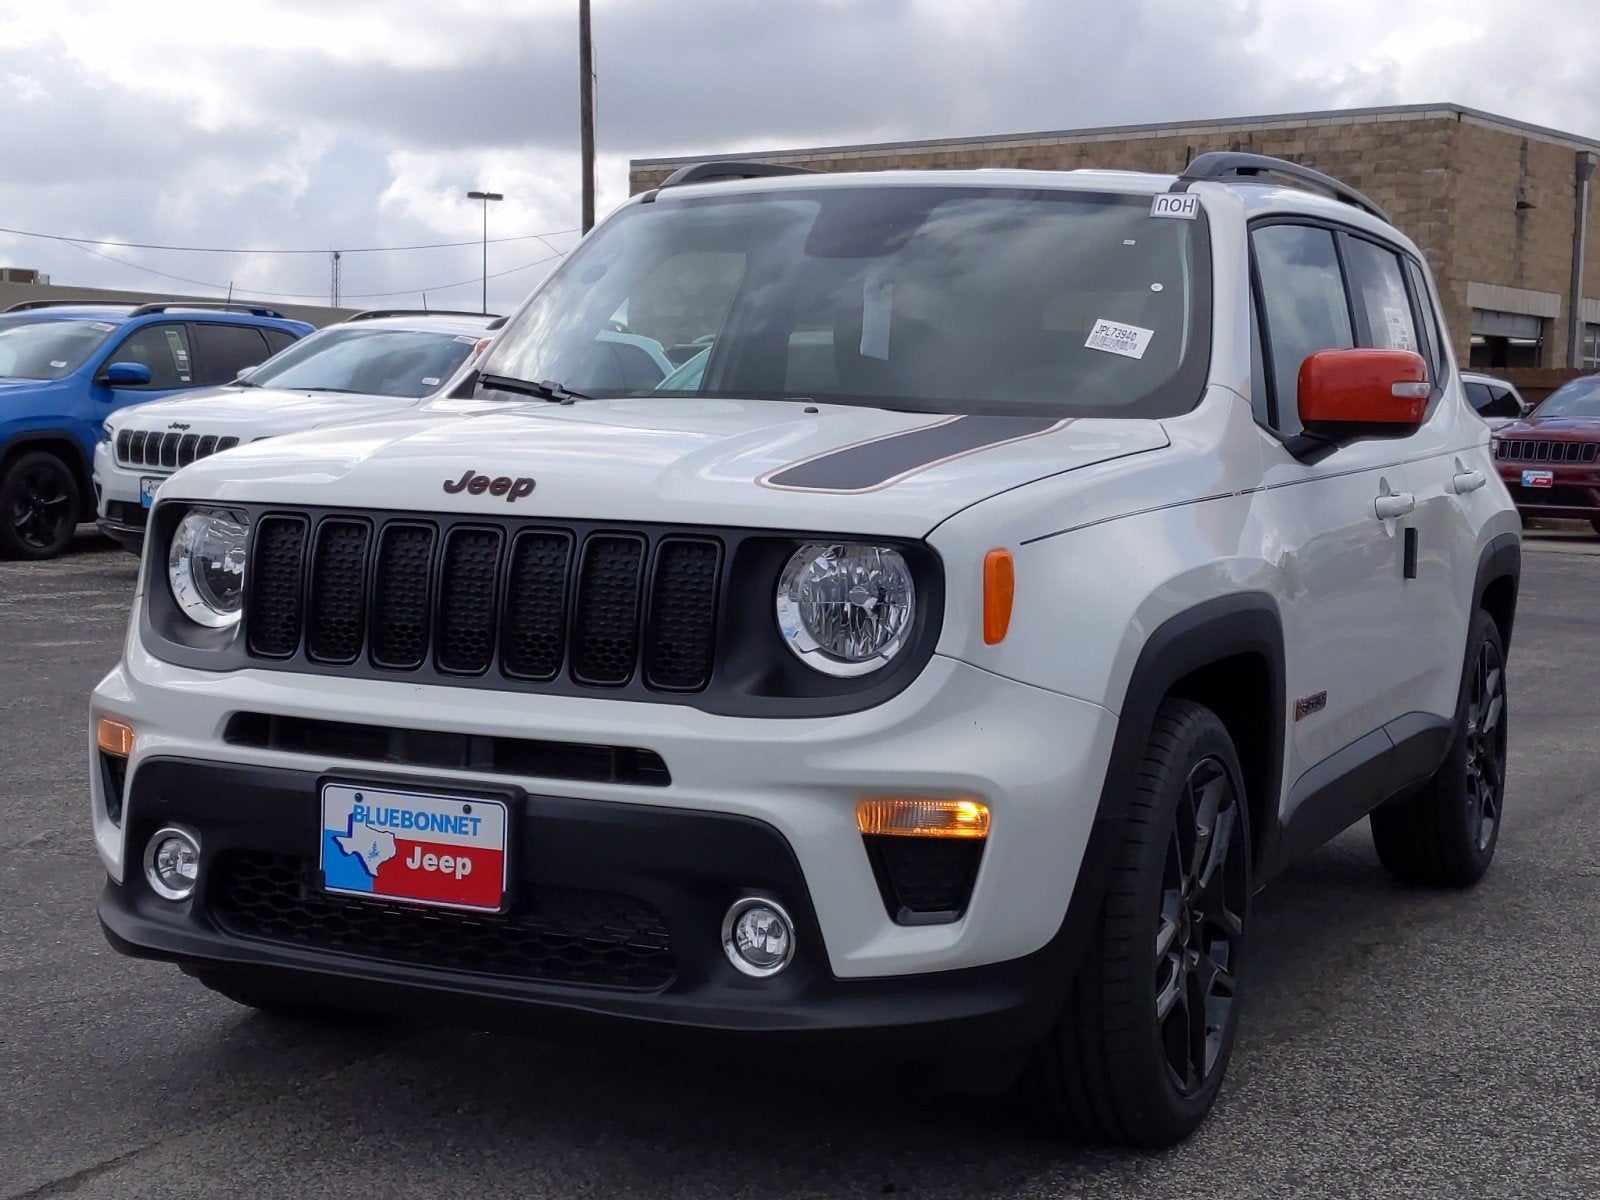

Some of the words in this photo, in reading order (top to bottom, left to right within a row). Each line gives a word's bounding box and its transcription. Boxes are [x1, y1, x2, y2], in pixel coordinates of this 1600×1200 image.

[443, 469, 537, 503] Jeep
[352, 804, 482, 837] BLUEBONNET
[405, 846, 473, 880] Jeep
